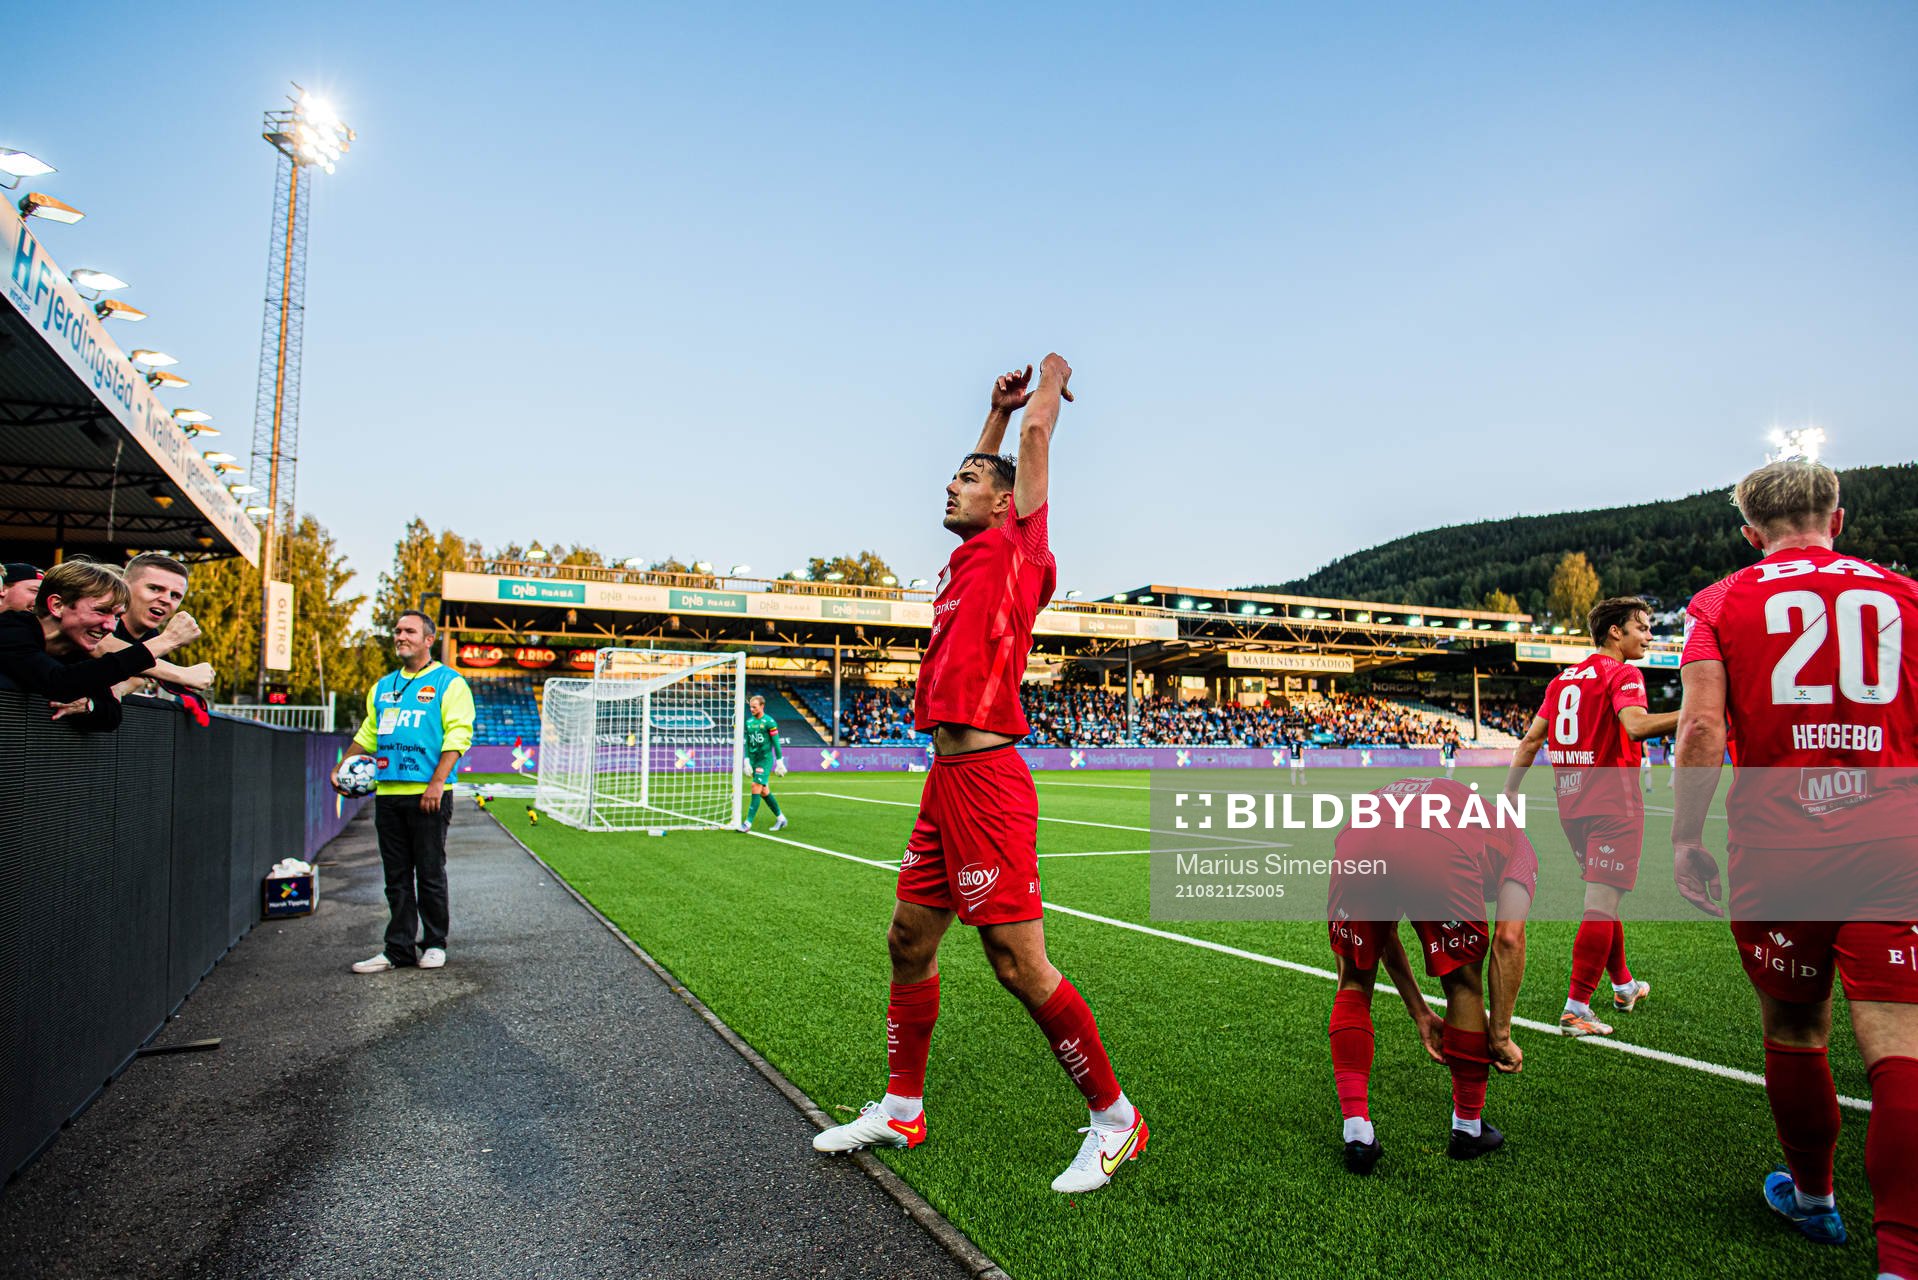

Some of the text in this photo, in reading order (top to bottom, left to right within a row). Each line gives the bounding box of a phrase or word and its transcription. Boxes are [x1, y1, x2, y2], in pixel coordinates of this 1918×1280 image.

[34, 260, 134, 412] Fjerdingstad
[1753, 558, 1885, 583] BA
[512, 583, 537, 598] DNB
[682, 594, 704, 608] DNB
[1764, 589, 1902, 704] 20
[1242, 655, 1352, 669] MARIENLYST STADION
[1559, 666, 1598, 681] BA
[1555, 684, 1582, 745] 8
[1791, 723, 1883, 752] HEGGEBØ
[396, 743, 426, 755] Tipping
[843, 753, 923, 767] Norsk Tipping
[1088, 753, 1153, 767] Norsk Tipping
[1565, 751, 1595, 764] MYHRE
[1384, 781, 1432, 793] MOT
[1559, 771, 1582, 789] MOT
[1808, 770, 1867, 801] MOT
[957, 869, 996, 887] LERØY
